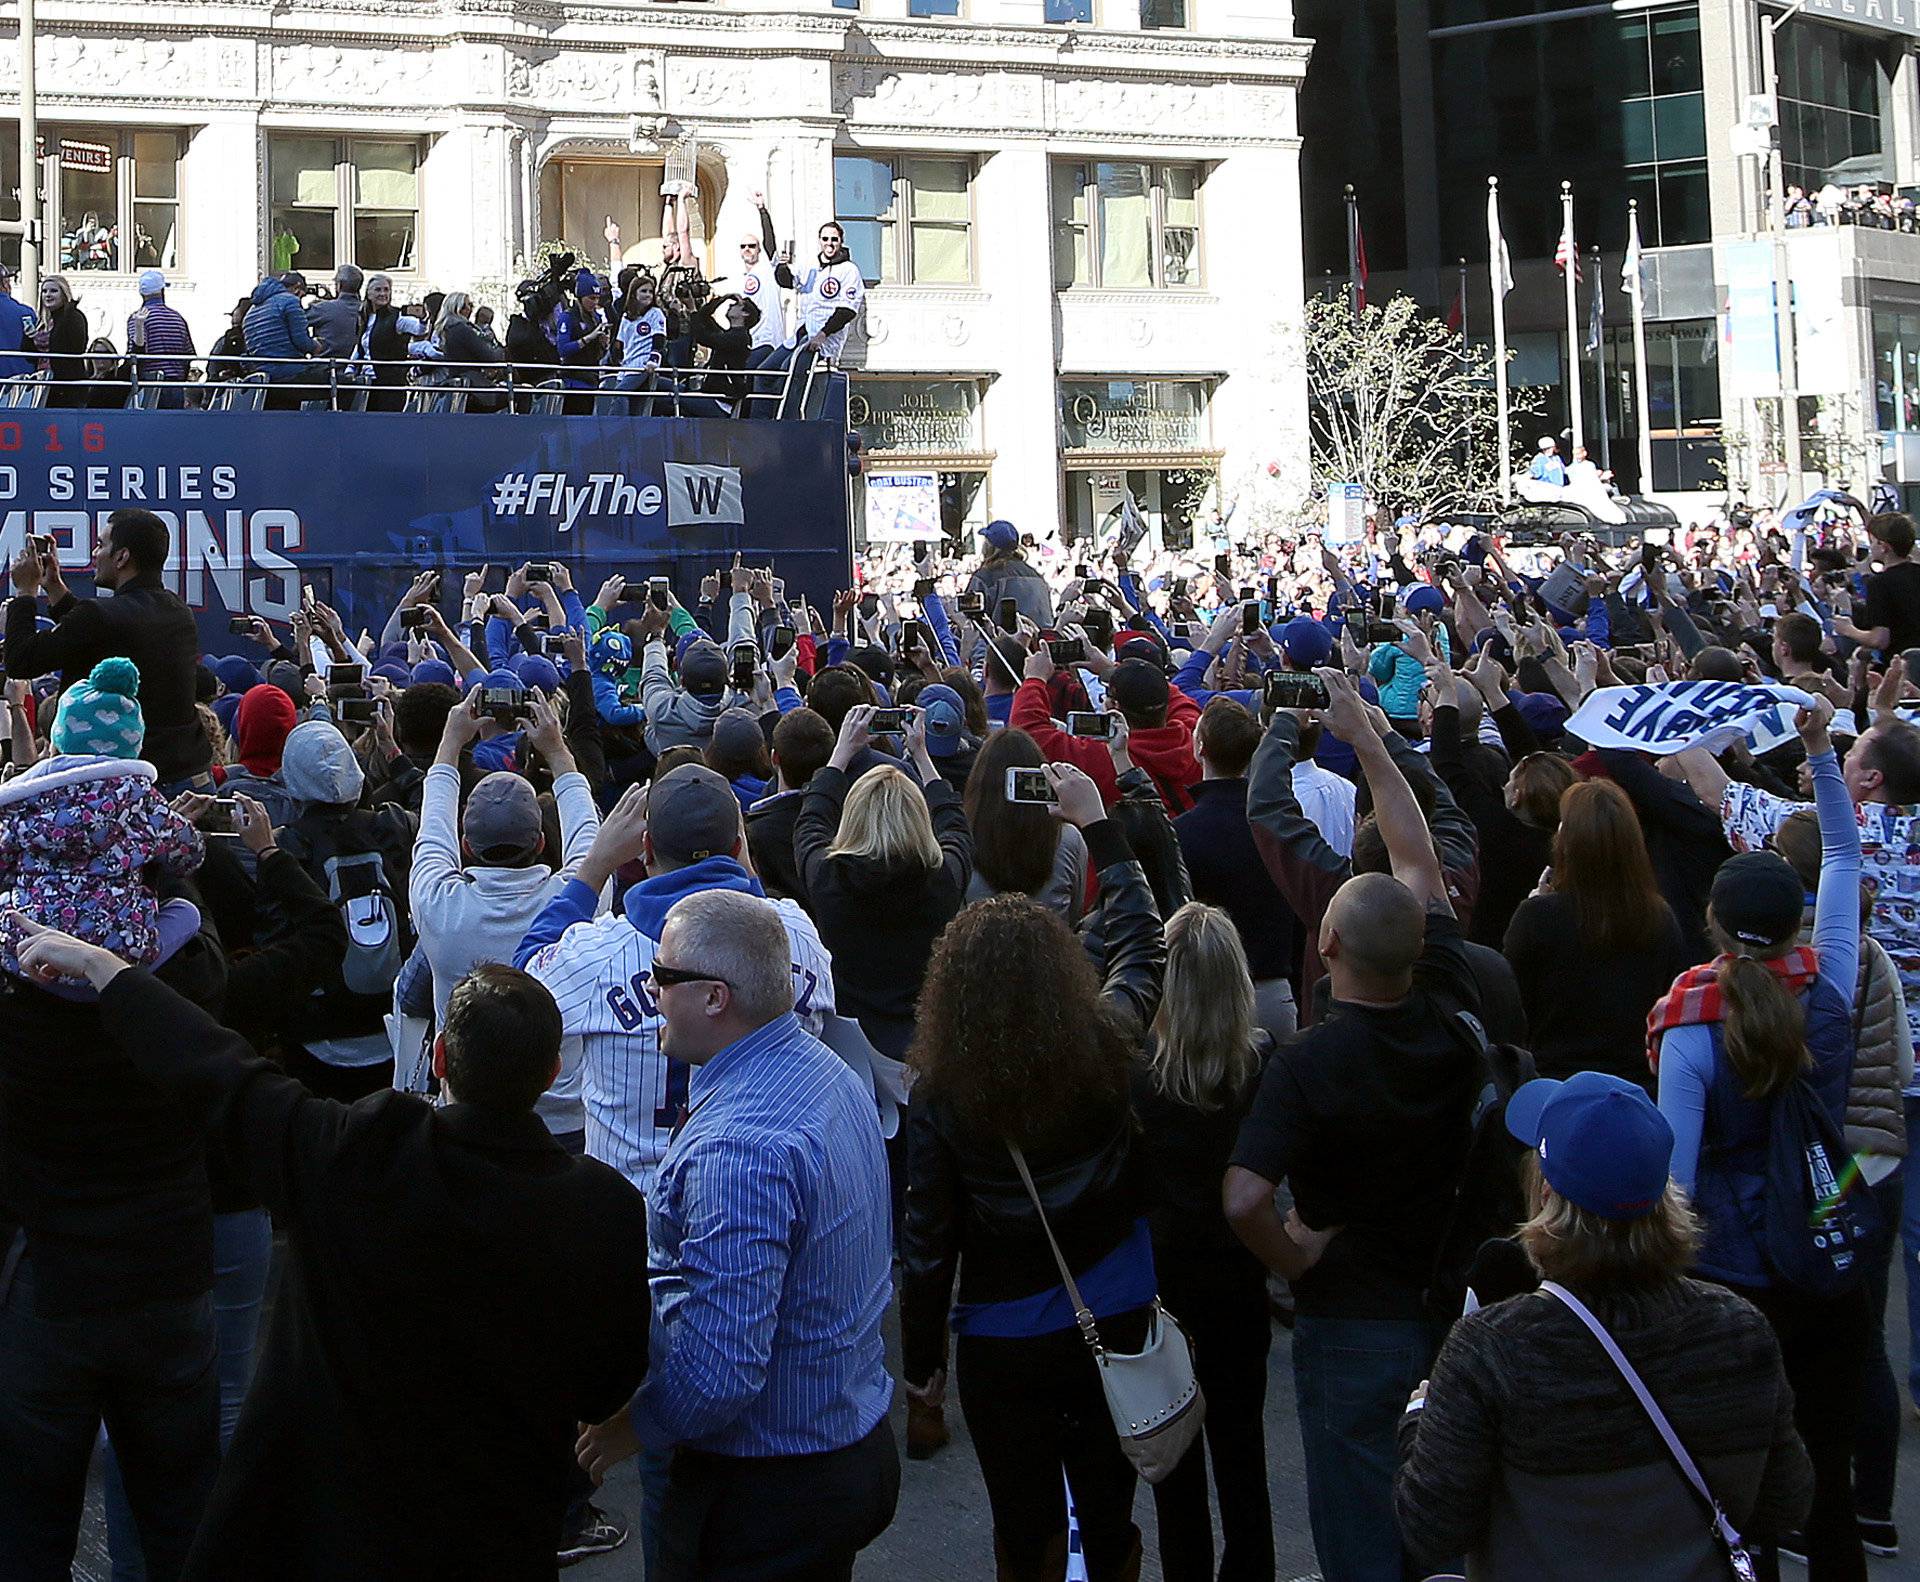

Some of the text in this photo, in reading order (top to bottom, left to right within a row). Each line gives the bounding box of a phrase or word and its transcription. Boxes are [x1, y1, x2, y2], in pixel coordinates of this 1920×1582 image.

[901, 394, 938, 408] JOEL
[50, 466, 236, 499] SERIES
[492, 473, 723, 532] #FlyThe W
